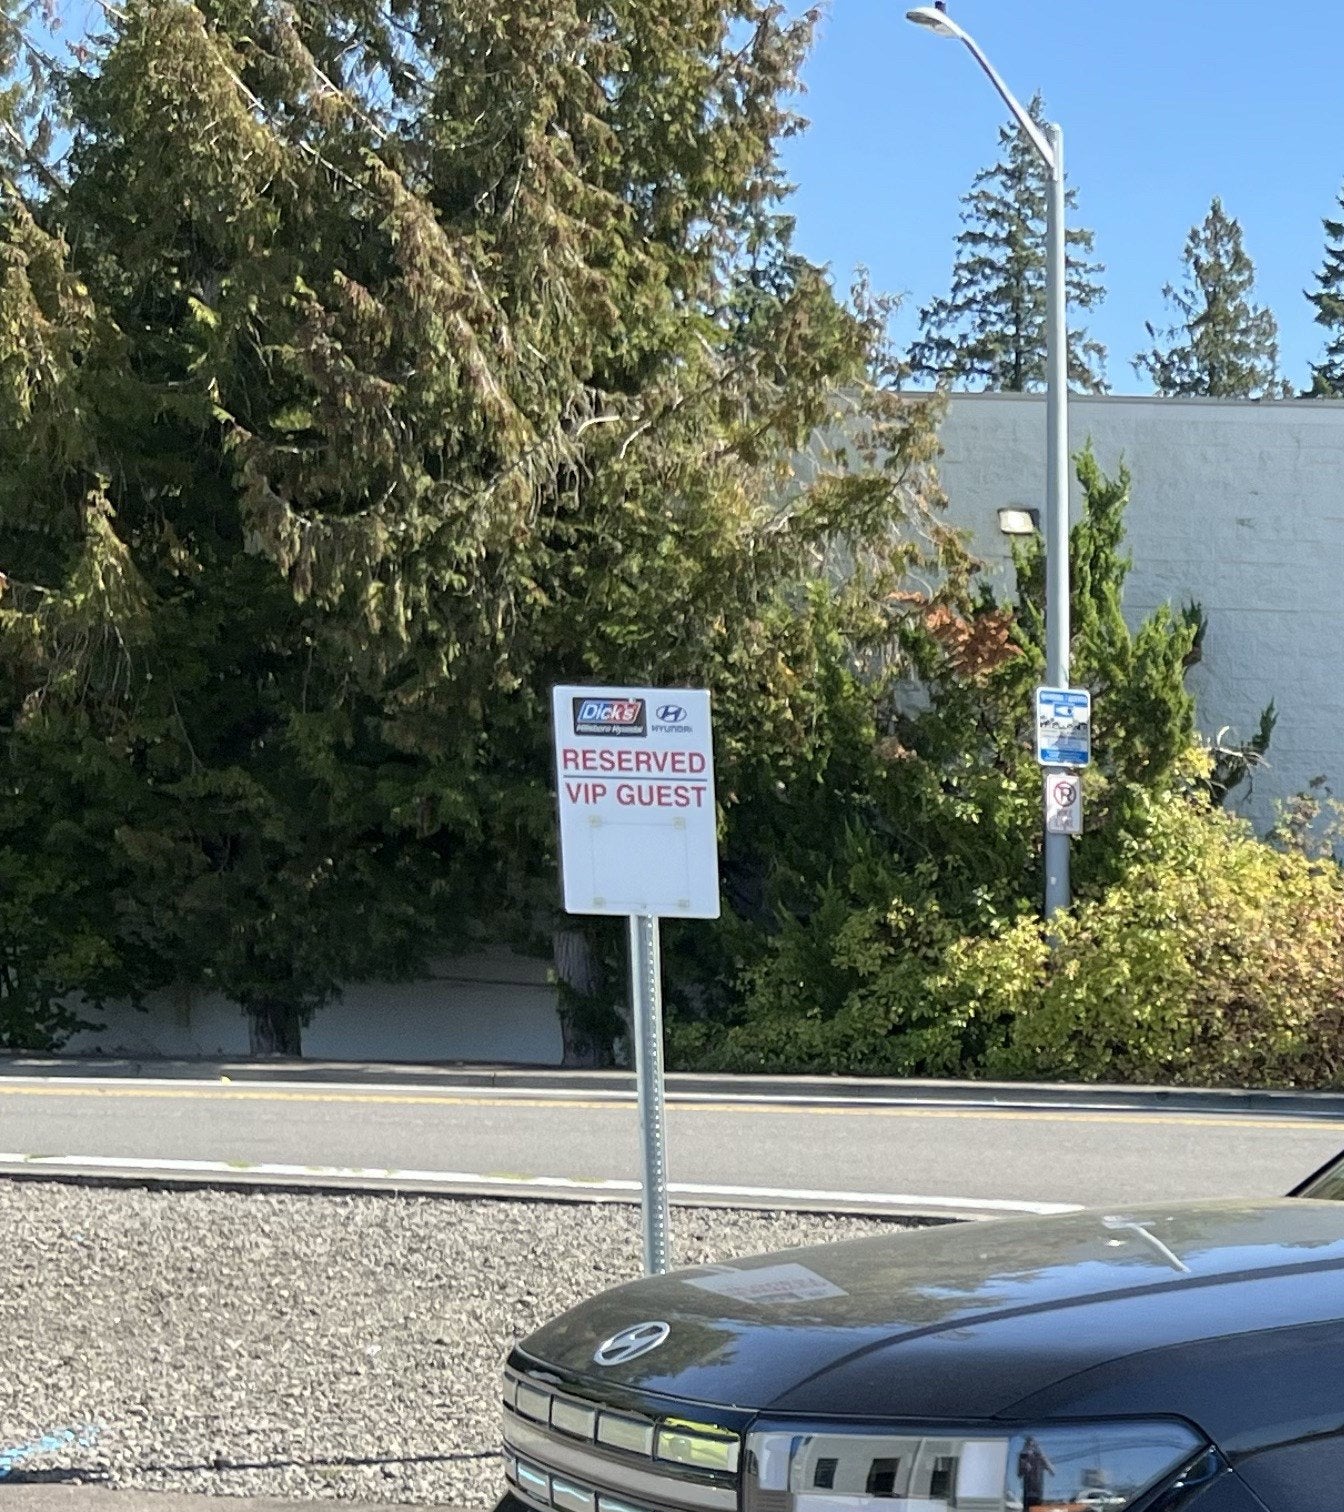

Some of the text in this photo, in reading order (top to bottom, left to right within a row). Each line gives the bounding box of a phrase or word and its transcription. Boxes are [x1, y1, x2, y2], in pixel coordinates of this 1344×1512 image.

[562, 748, 706, 774] RESERVED
[565, 782, 707, 808] VIP GUEST
